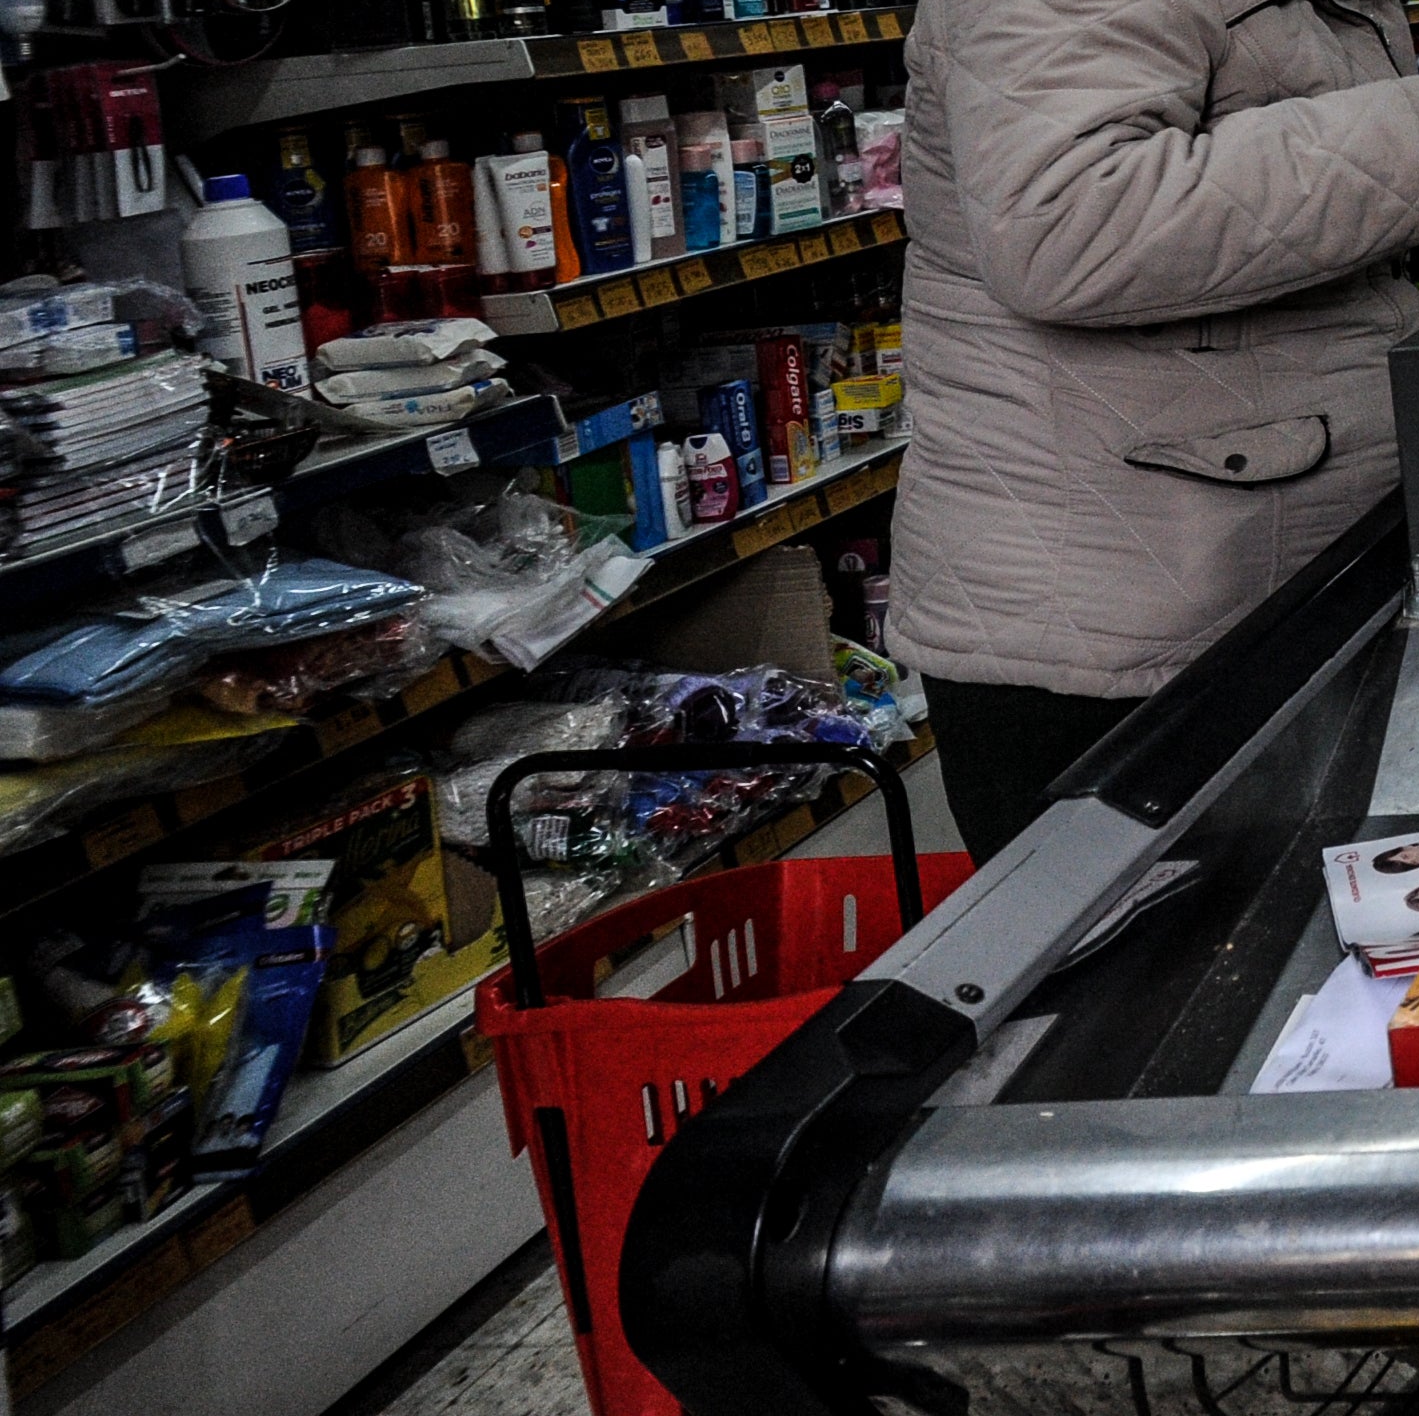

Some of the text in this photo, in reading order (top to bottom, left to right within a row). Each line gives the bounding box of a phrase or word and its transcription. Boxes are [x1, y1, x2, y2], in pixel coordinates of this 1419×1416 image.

[437, 223, 461, 237] 20
[365, 232, 387, 247] 20
[262, 365, 298, 381] NEO
[785, 344, 802, 416] Colgate
[349, 796, 396, 826] PACK
[398, 783, 418, 811] 3
